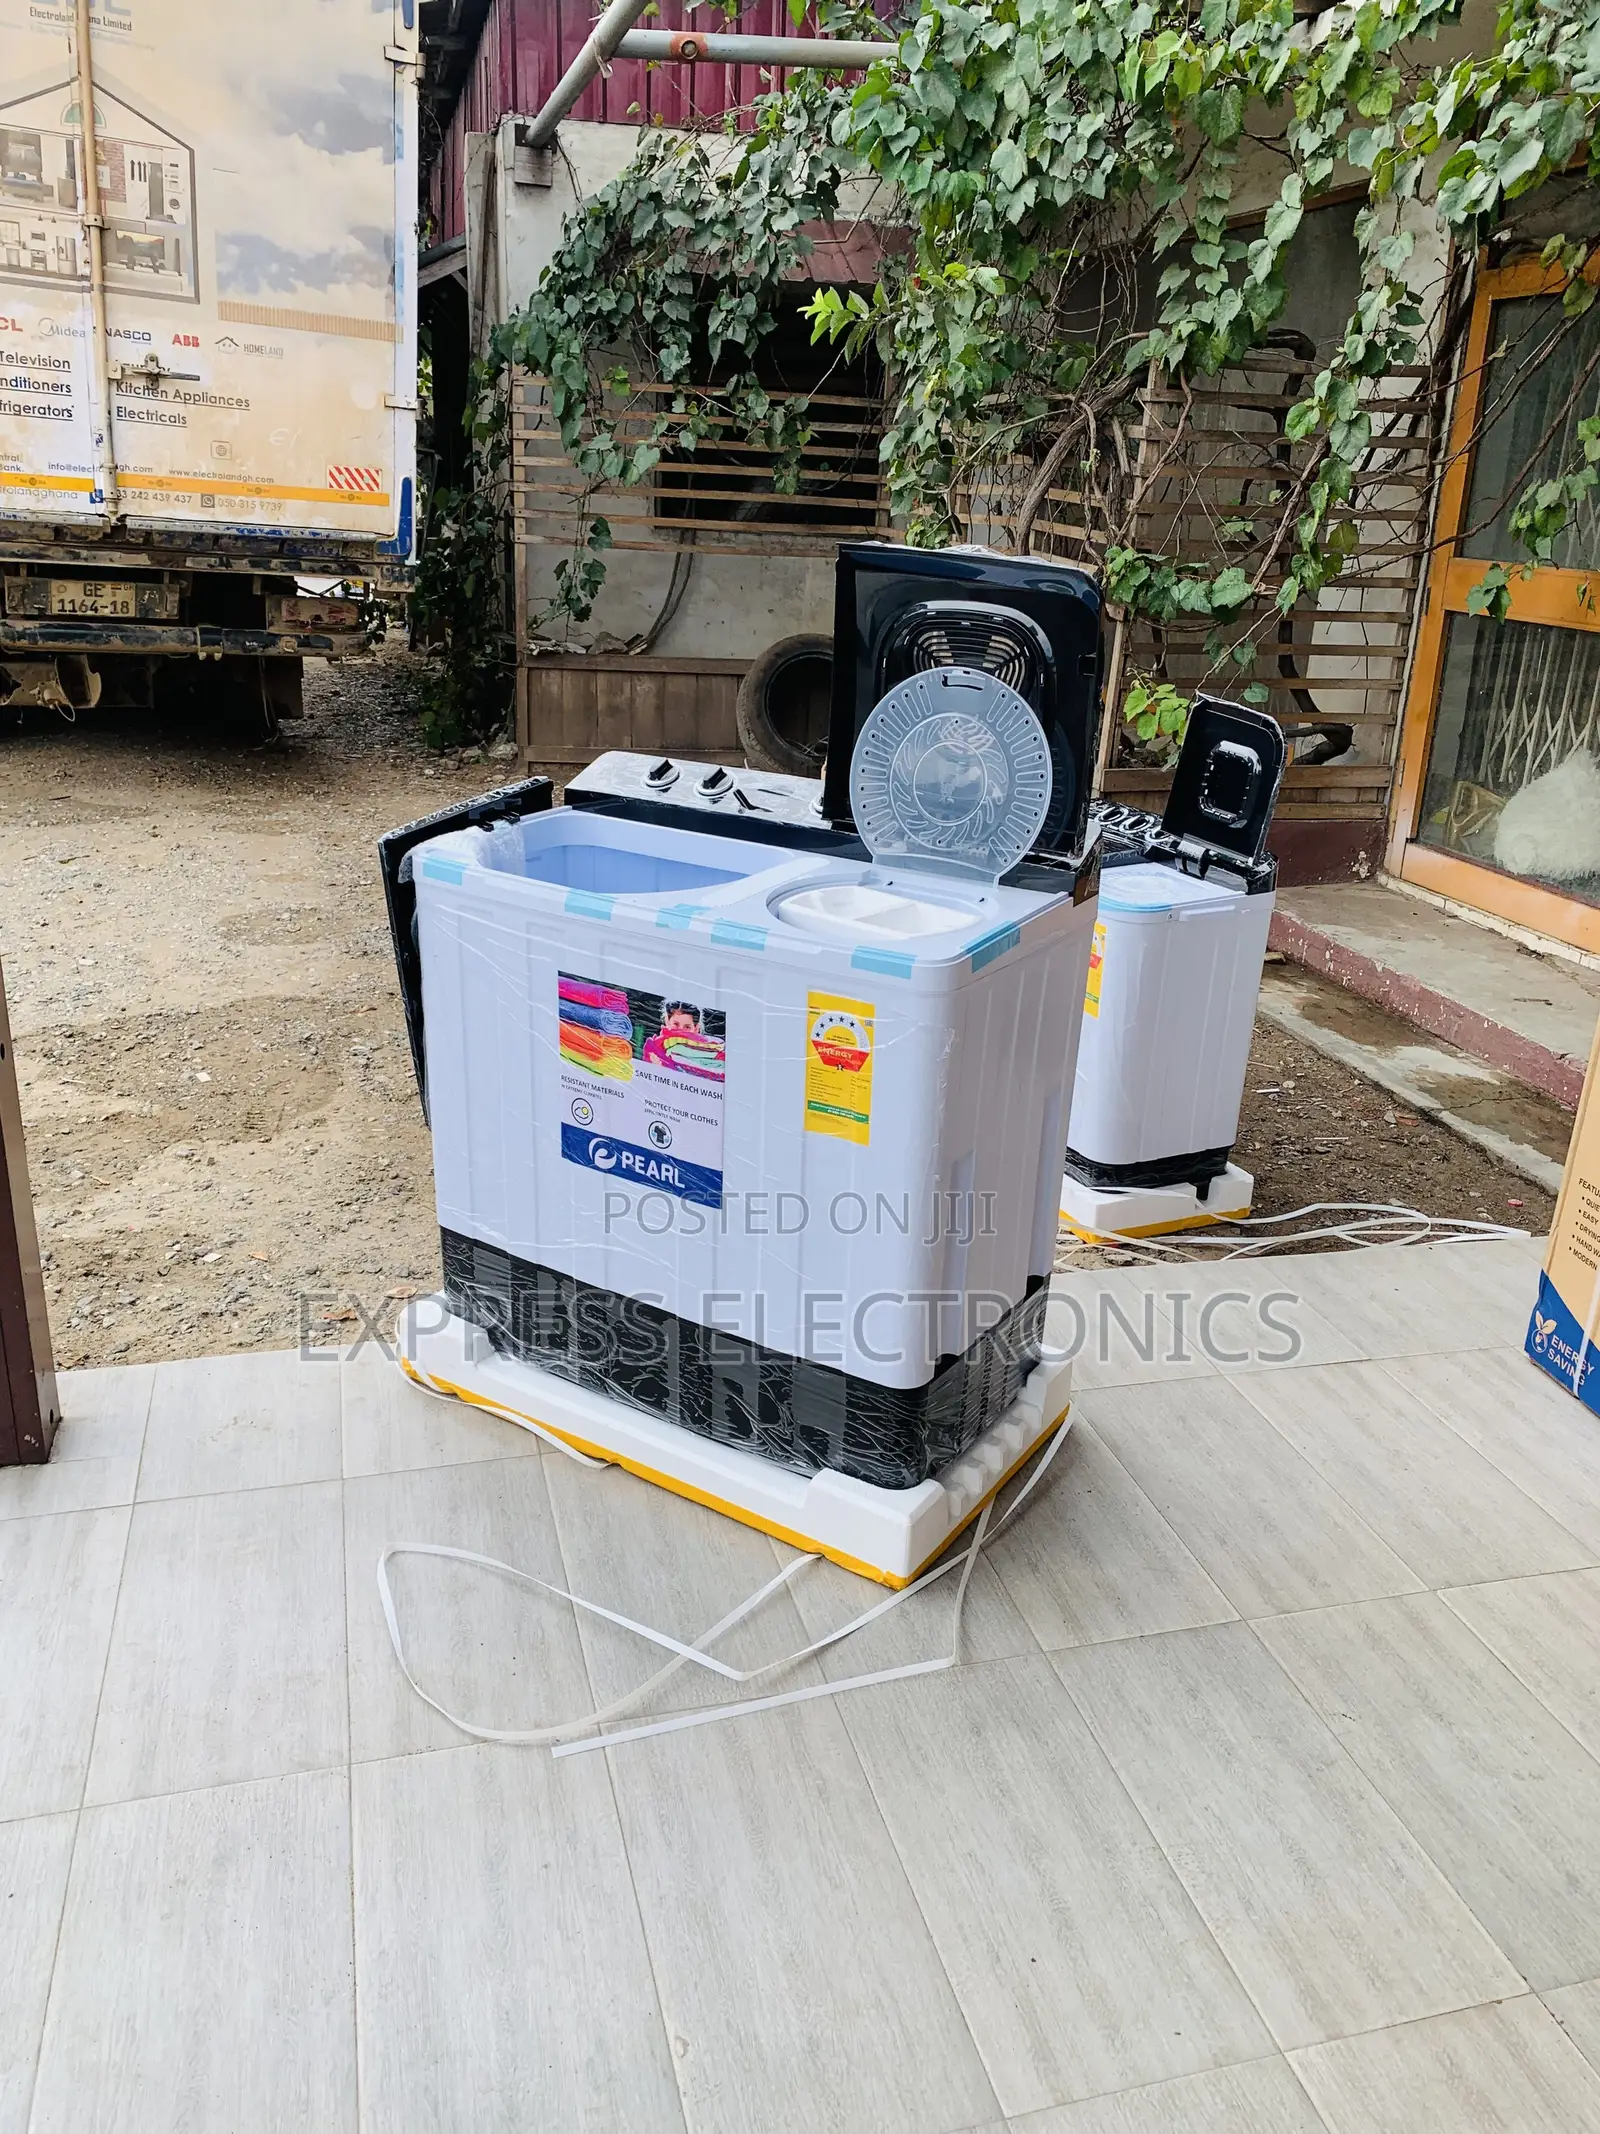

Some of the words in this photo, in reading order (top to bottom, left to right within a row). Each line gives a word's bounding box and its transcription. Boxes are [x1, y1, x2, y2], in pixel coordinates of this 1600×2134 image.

[103, 16, 132, 31] Limited
[47, 323, 86, 338] Midea
[105, 328, 152, 341] NASCO
[172, 334, 200, 348] ABB
[243, 343, 284, 358] HOMELAND
[0, 351, 71, 370] Television
[116, 382, 168, 399] Kitchen
[173, 389, 250, 408] Appliances
[116, 406, 187, 425] Electricals
[169, 468, 274, 484] www.electrolandgh.com
[131, 490, 149, 501] 242
[152, 492, 171, 503] 439
[174, 494, 192, 504] 437
[259, 501, 282, 511] 9739
[83, 582, 105, 597] GE
[57, 599, 129, 614] 1164-18
[561, 1074, 590, 1089] RESISTANT
[591, 1084, 625, 1099] MATERIALS
[635, 1070, 652, 1080] SAVE
[654, 1075, 671, 1086] TIME
[671, 1080, 679, 1089] IN
[680, 1083, 698, 1095] EACH
[700, 1088, 723, 1100] WASH
[644, 1099, 671, 1113] PROTECT
[672, 1107, 689, 1118] YOUR
[690, 1113, 719, 1126] CLOTHES
[621, 1151, 686, 1189] PEARL
[1582, 1210, 1599, 1226] EASY
[1576, 1235, 1592, 1252] HAND
[1572, 1248, 1597, 1271] MODERN
